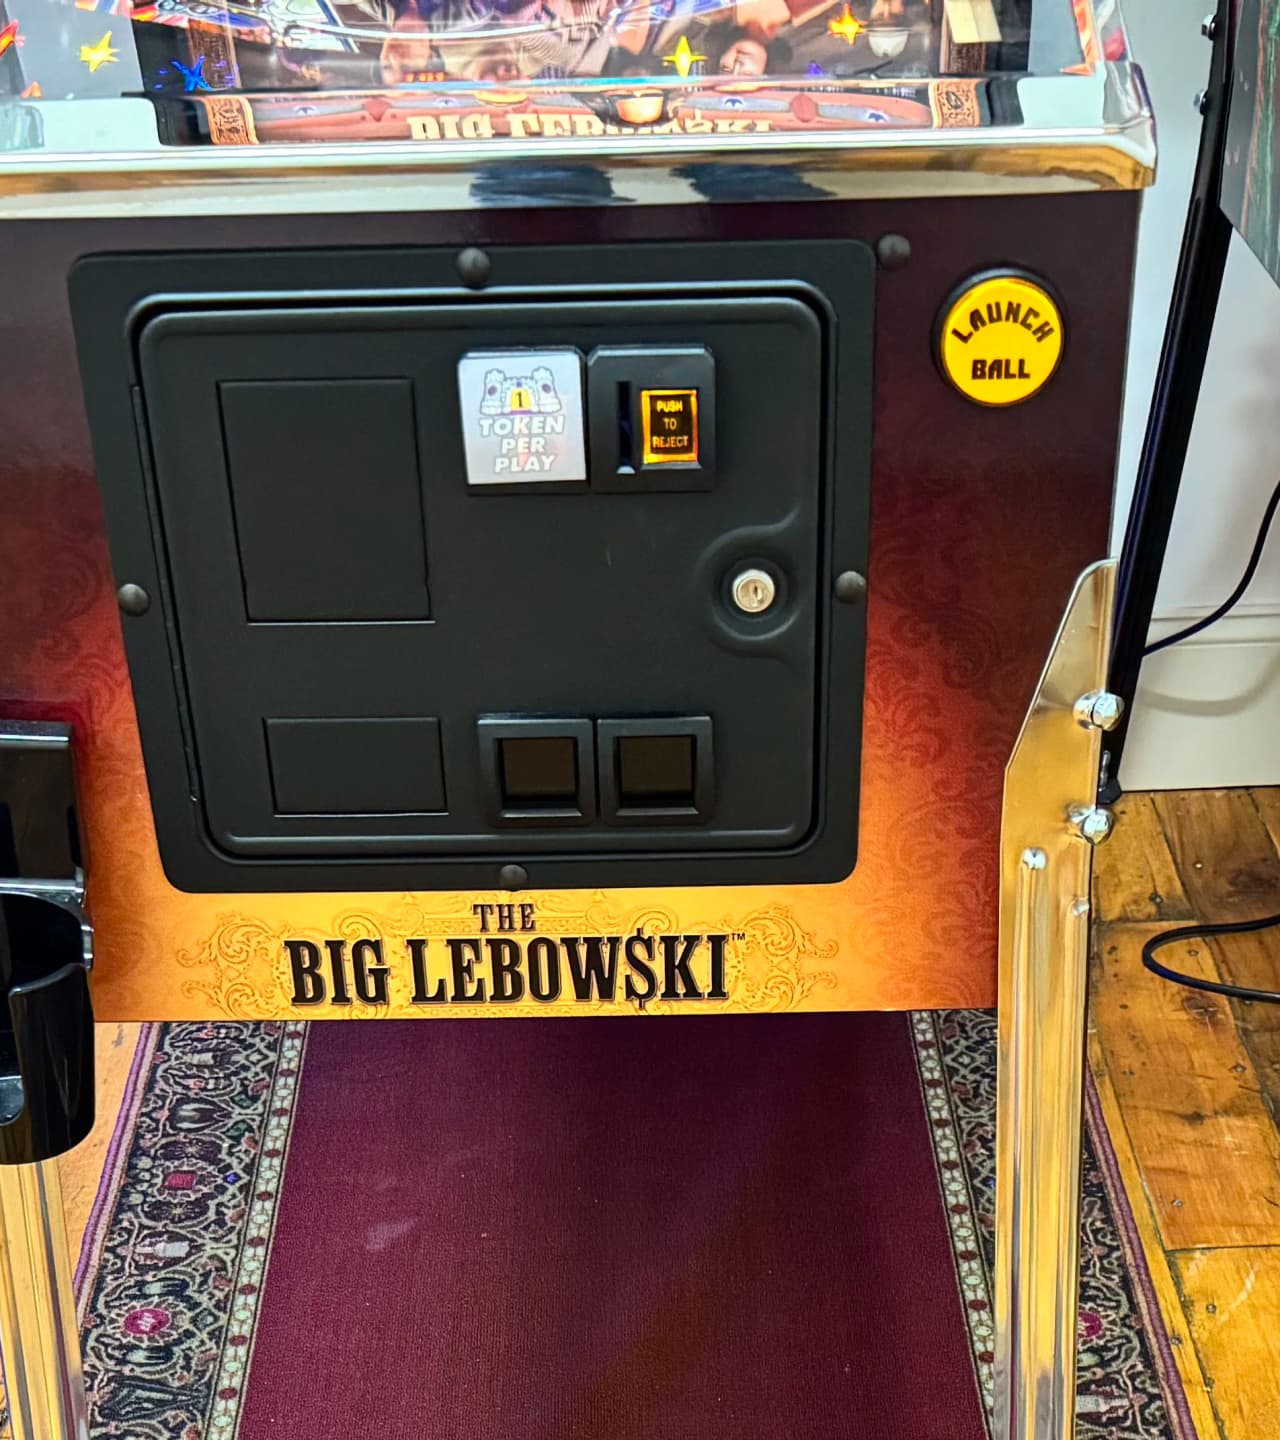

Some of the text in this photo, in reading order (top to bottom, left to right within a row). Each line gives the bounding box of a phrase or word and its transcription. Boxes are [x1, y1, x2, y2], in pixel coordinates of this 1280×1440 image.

[951, 300, 1055, 344] LAUNCH
[971, 358, 1031, 380] BALL
[656, 400, 683, 413] PUSH
[479, 415, 566, 437] TOKEN
[663, 417, 678, 430] TO
[501, 436, 545, 454] PER
[652, 435, 690, 449] REJECT
[494, 455, 556, 474] PLAY
[472, 903, 537, 933] THE
[283, 938, 393, 1006] BIG
